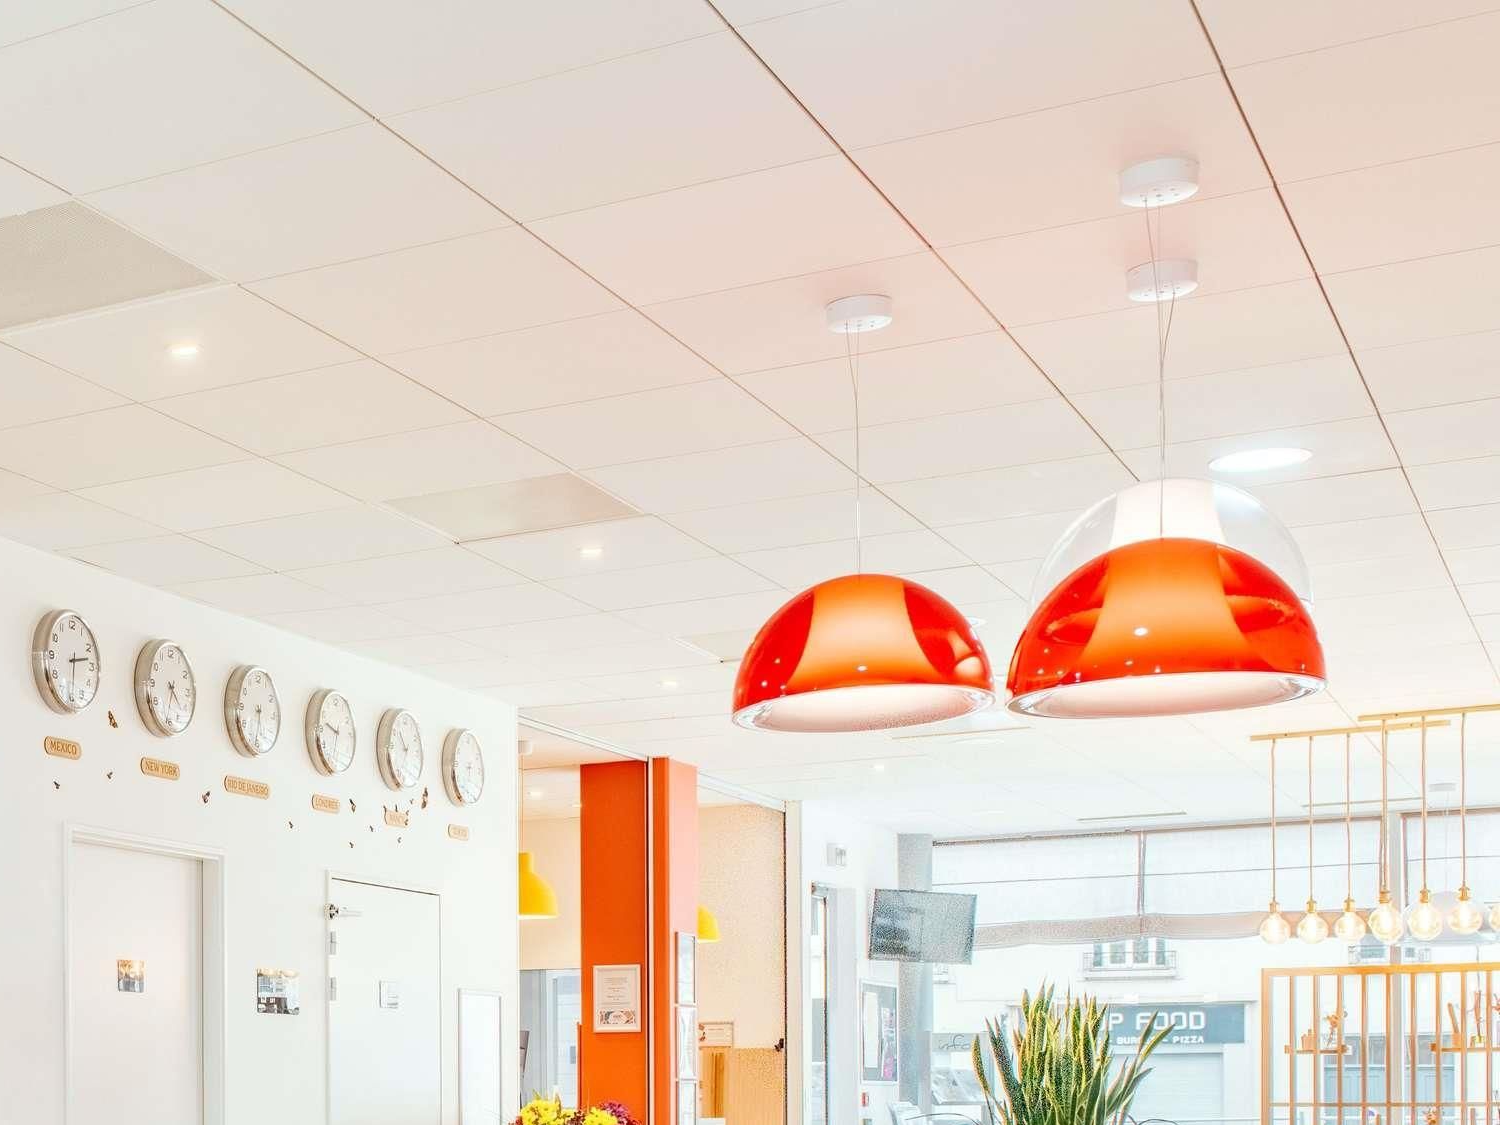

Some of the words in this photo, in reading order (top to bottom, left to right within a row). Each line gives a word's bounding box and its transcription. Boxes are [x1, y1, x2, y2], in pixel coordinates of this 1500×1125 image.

[49, 740, 78, 756] MEXICO
[145, 760, 160, 773] NEW
[160, 763, 178, 777] YORK
[1135, 1011, 1206, 1031] FOOD
[1172, 1035, 1204, 1044] PIZZA
